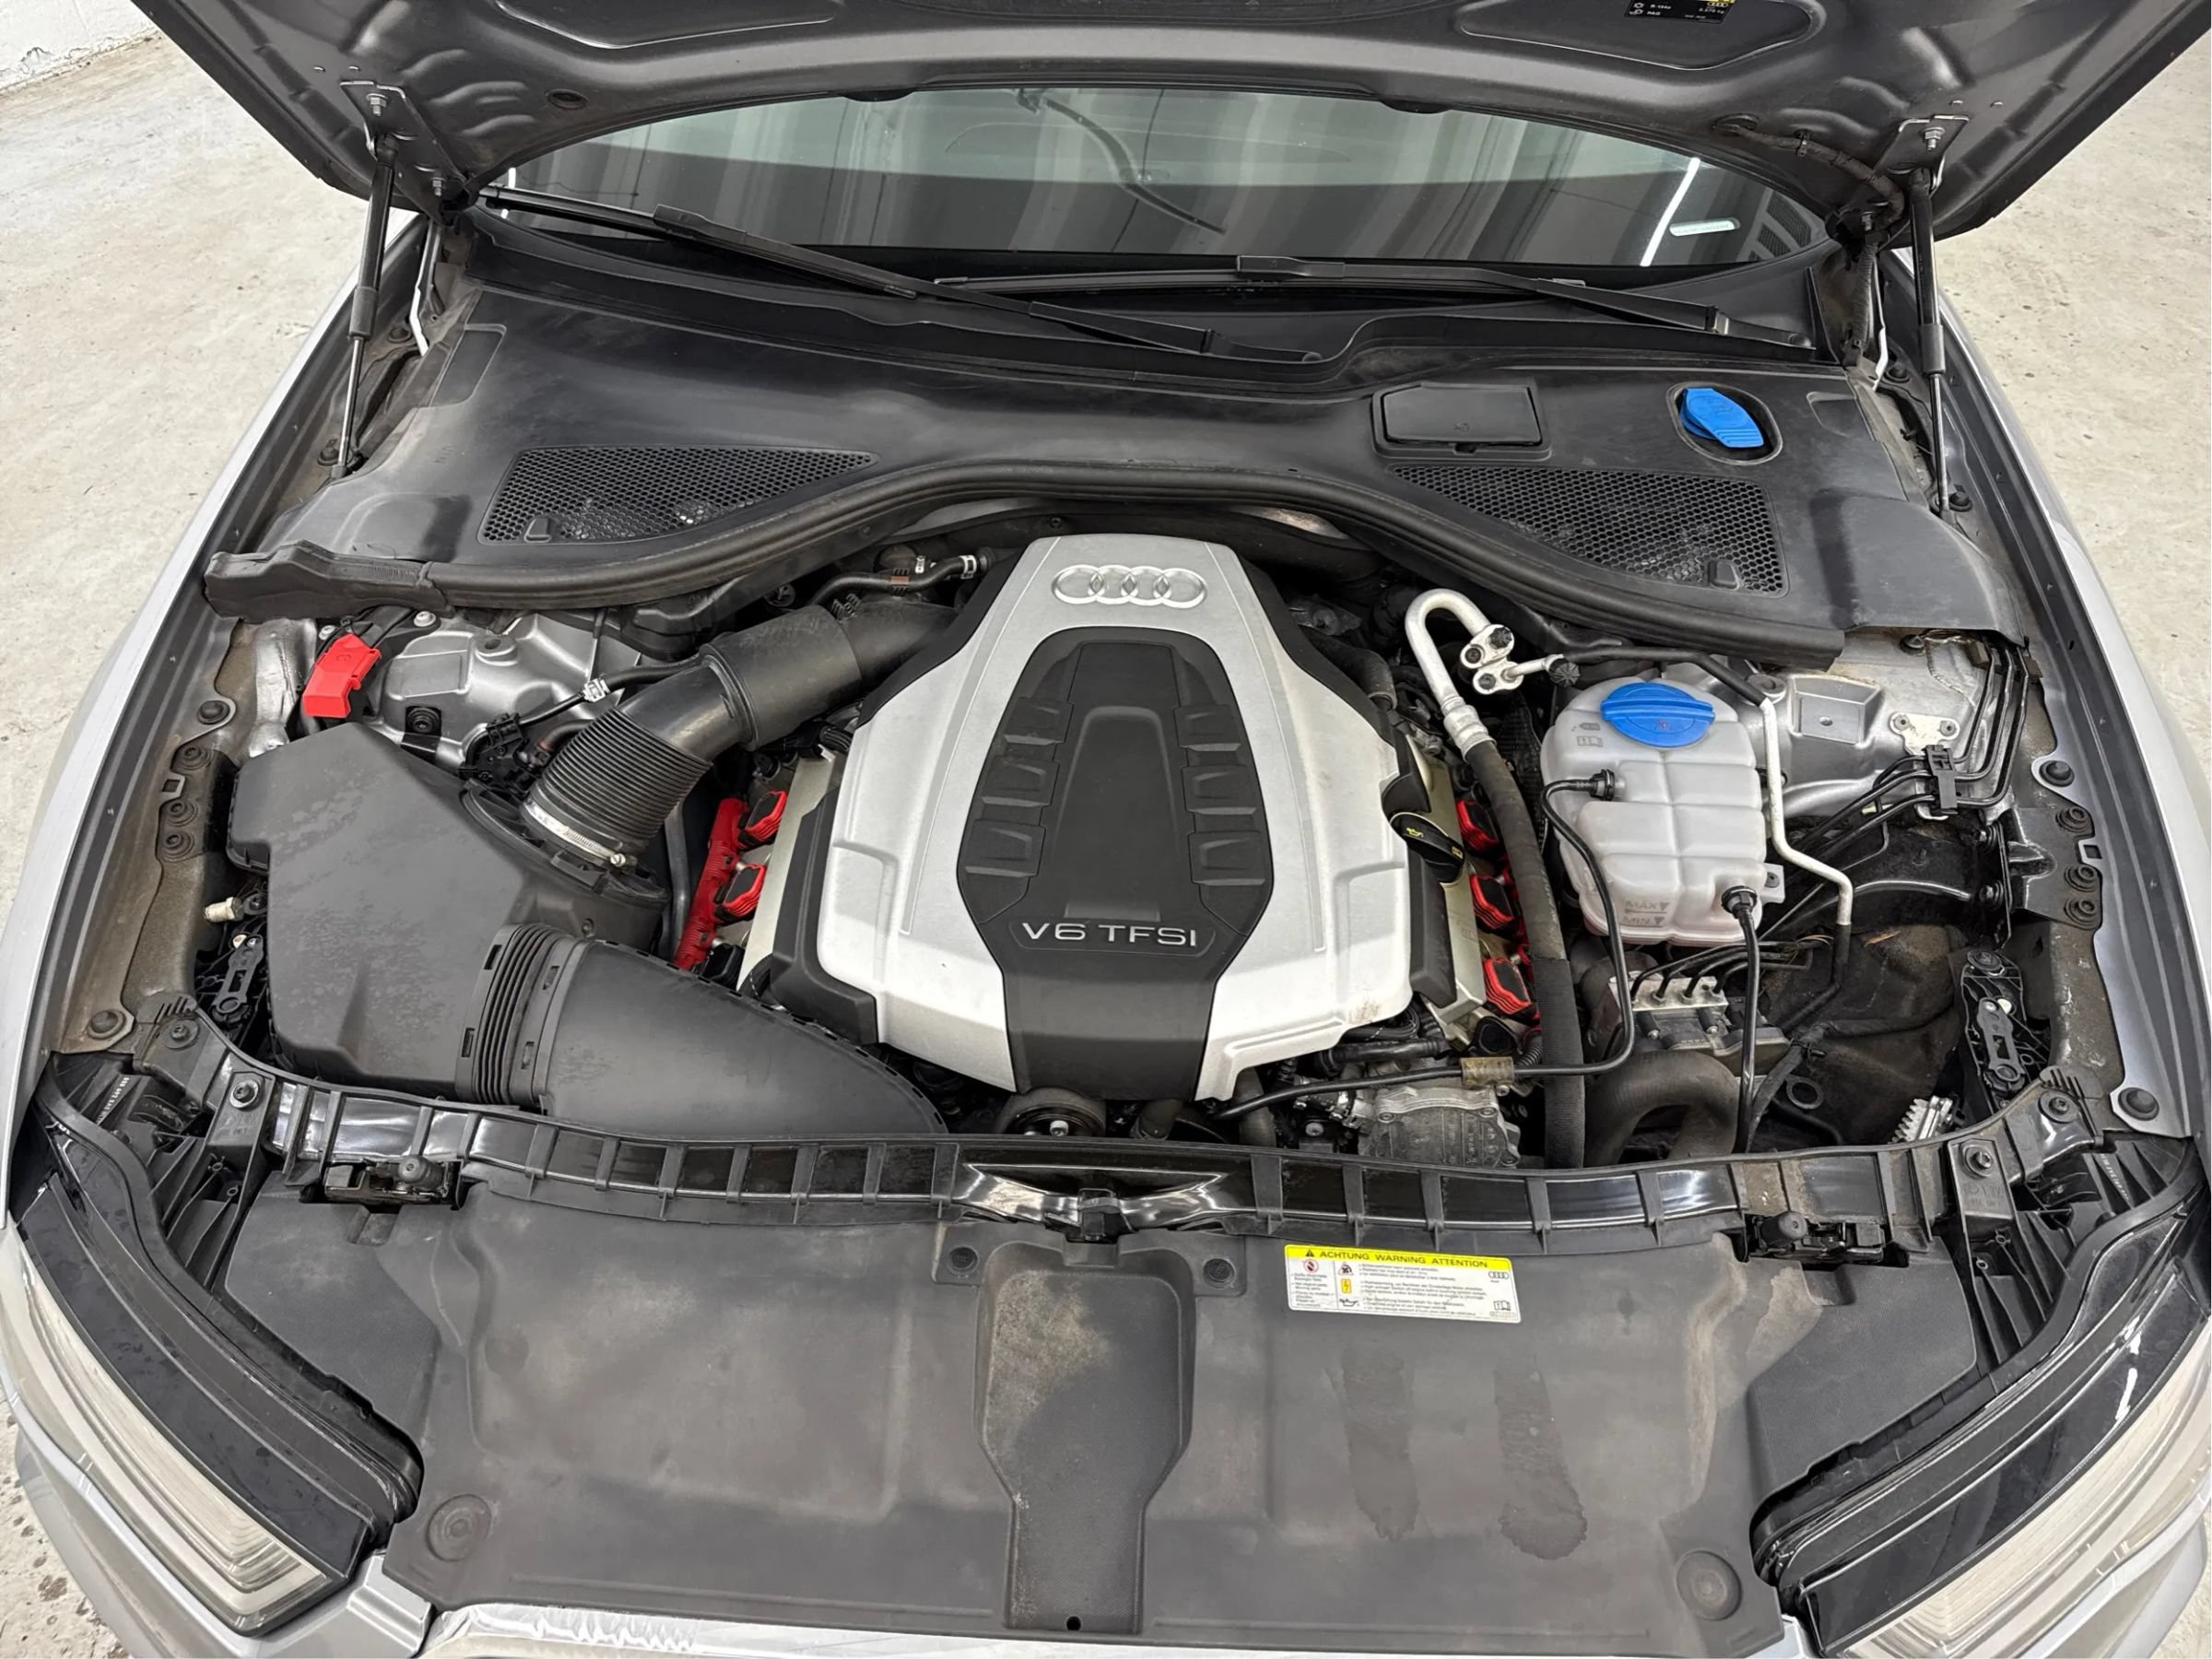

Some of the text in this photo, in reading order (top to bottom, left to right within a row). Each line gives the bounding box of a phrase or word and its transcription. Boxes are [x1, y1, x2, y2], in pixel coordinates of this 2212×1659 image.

[1021, 923, 1197, 947] V6 TFSI
[1319, 1251, 1488, 1268] ACHTUNG WARNING ATTENTION
